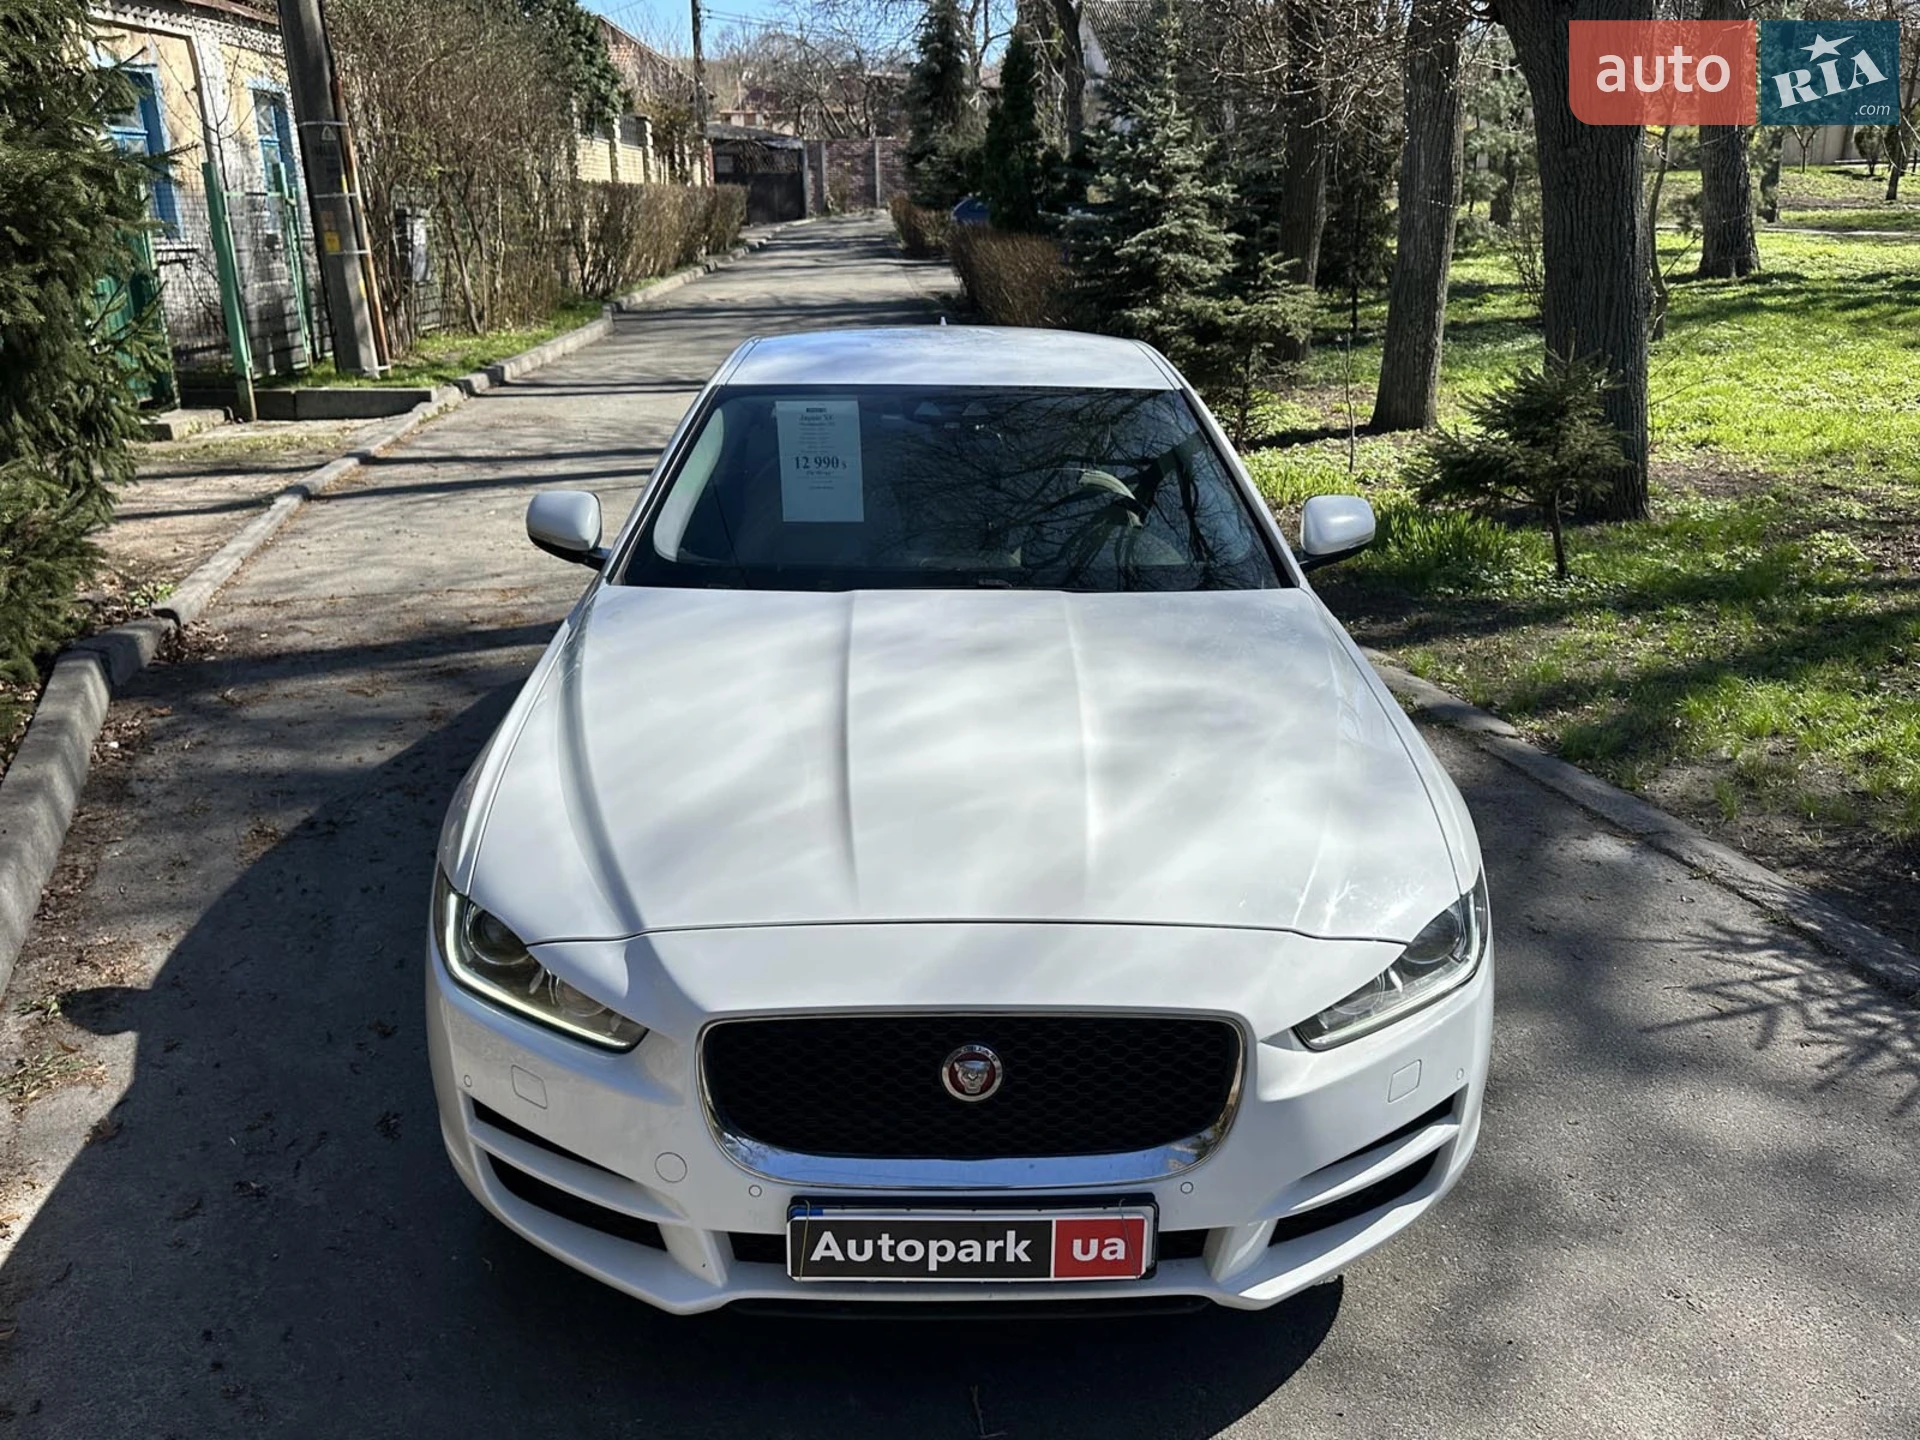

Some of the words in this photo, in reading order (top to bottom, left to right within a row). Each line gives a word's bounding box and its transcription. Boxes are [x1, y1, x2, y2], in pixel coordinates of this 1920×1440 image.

[795, 456, 810, 469] 12
[814, 456, 839, 469] 990
[810, 1230, 1032, 1271] Autopark
[1072, 1237, 1126, 1261] ua
